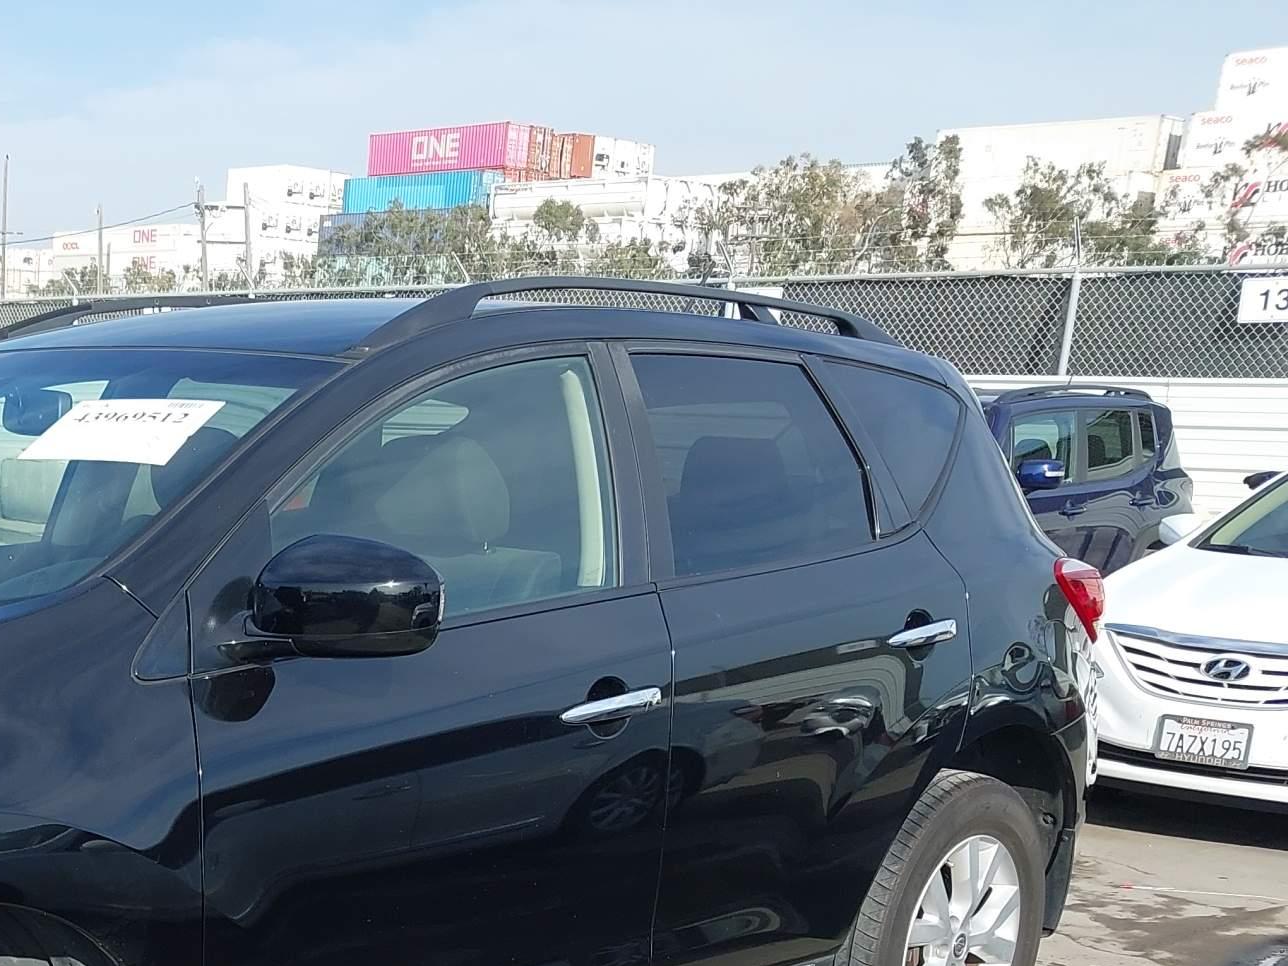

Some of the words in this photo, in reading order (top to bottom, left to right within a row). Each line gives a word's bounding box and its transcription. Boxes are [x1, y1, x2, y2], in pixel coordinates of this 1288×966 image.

[1200, 116, 1232, 126] seaco
[412, 132, 460, 160] ONE
[1169, 173, 1201, 184] seaco
[133, 228, 158, 244] ONE
[1166, 731, 1243, 760] 7AZX195
